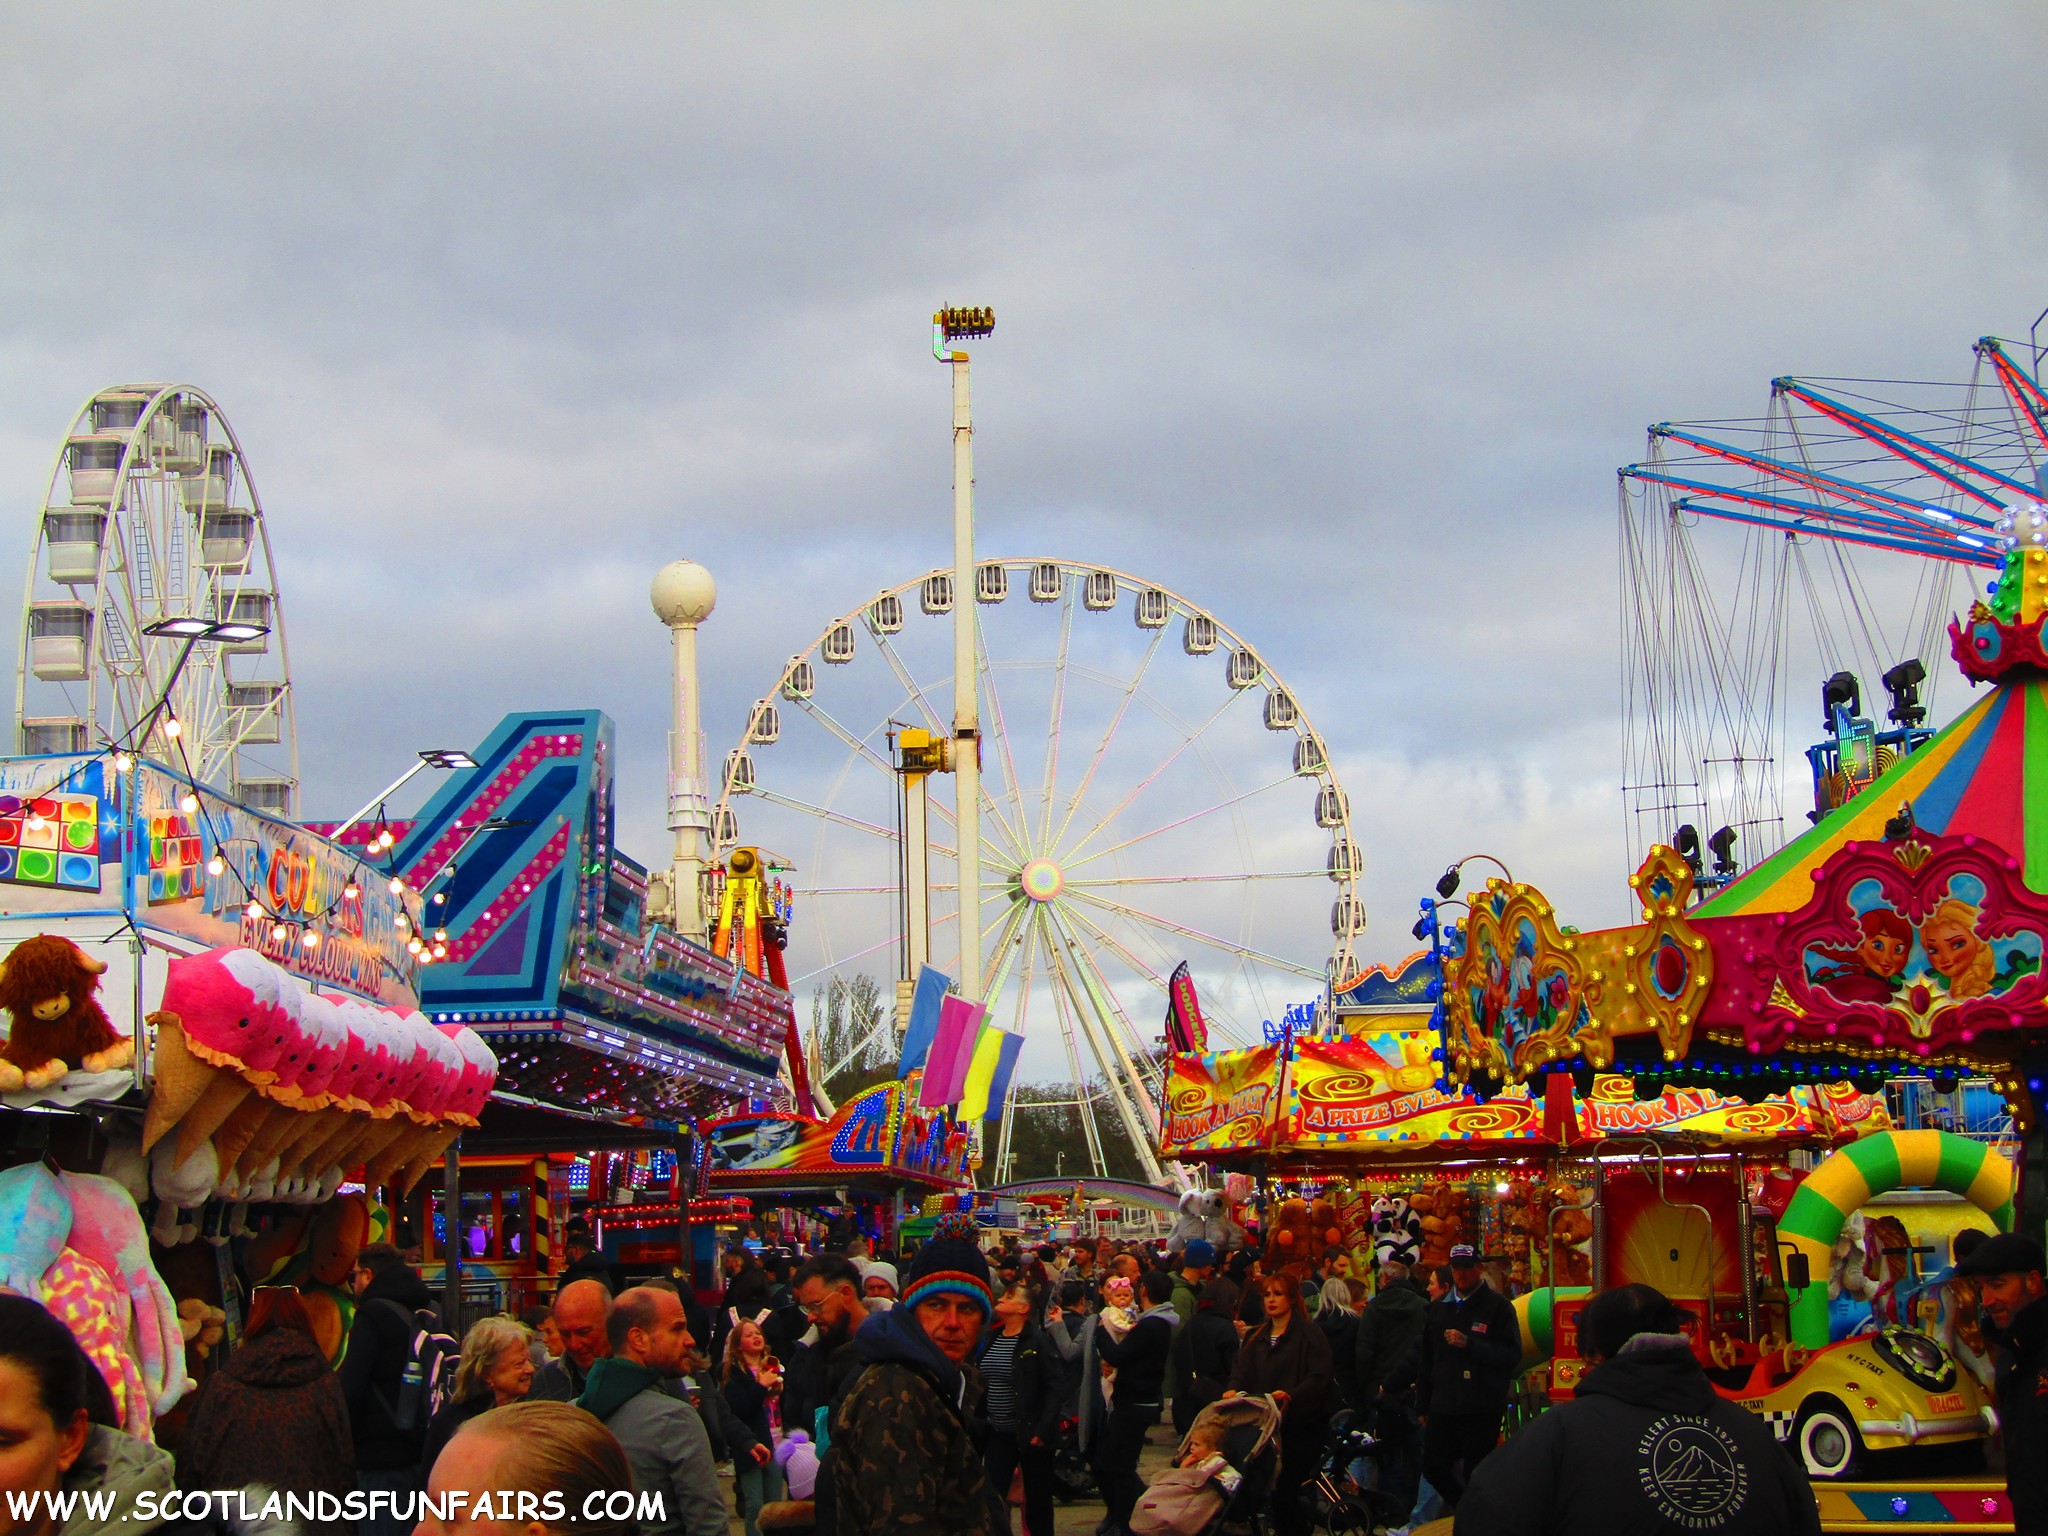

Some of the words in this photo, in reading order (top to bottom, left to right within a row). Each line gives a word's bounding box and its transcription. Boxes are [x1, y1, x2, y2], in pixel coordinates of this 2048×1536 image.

[238, 913, 299, 964] EVERY
[299, 931, 351, 984] COLOUR
[355, 950, 384, 997] WINS
[1173, 1109, 1213, 1142] HOOK
[1212, 1105, 1226, 1131] A
[1227, 1085, 1265, 1122] DUCK
[1307, 1106, 1326, 1127] A
[1328, 1103, 1392, 1127] PRIZE
[1392, 1083, 1464, 1117] EVERY
[1595, 1097, 1676, 1130] HOOK
[1676, 1092, 1702, 1118] A
[1865, 1361, 1886, 1377] TAXY
[1638, 1417, 1670, 1455] GELERT
[1673, 1414, 1709, 1428] SINCE
[1715, 1425, 1739, 1453] 1975
[1638, 1467, 1660, 1499] KEEP
[1657, 1501, 1725, 1529] EXPLORING
[1727, 1463, 1748, 1517] FOREVER
